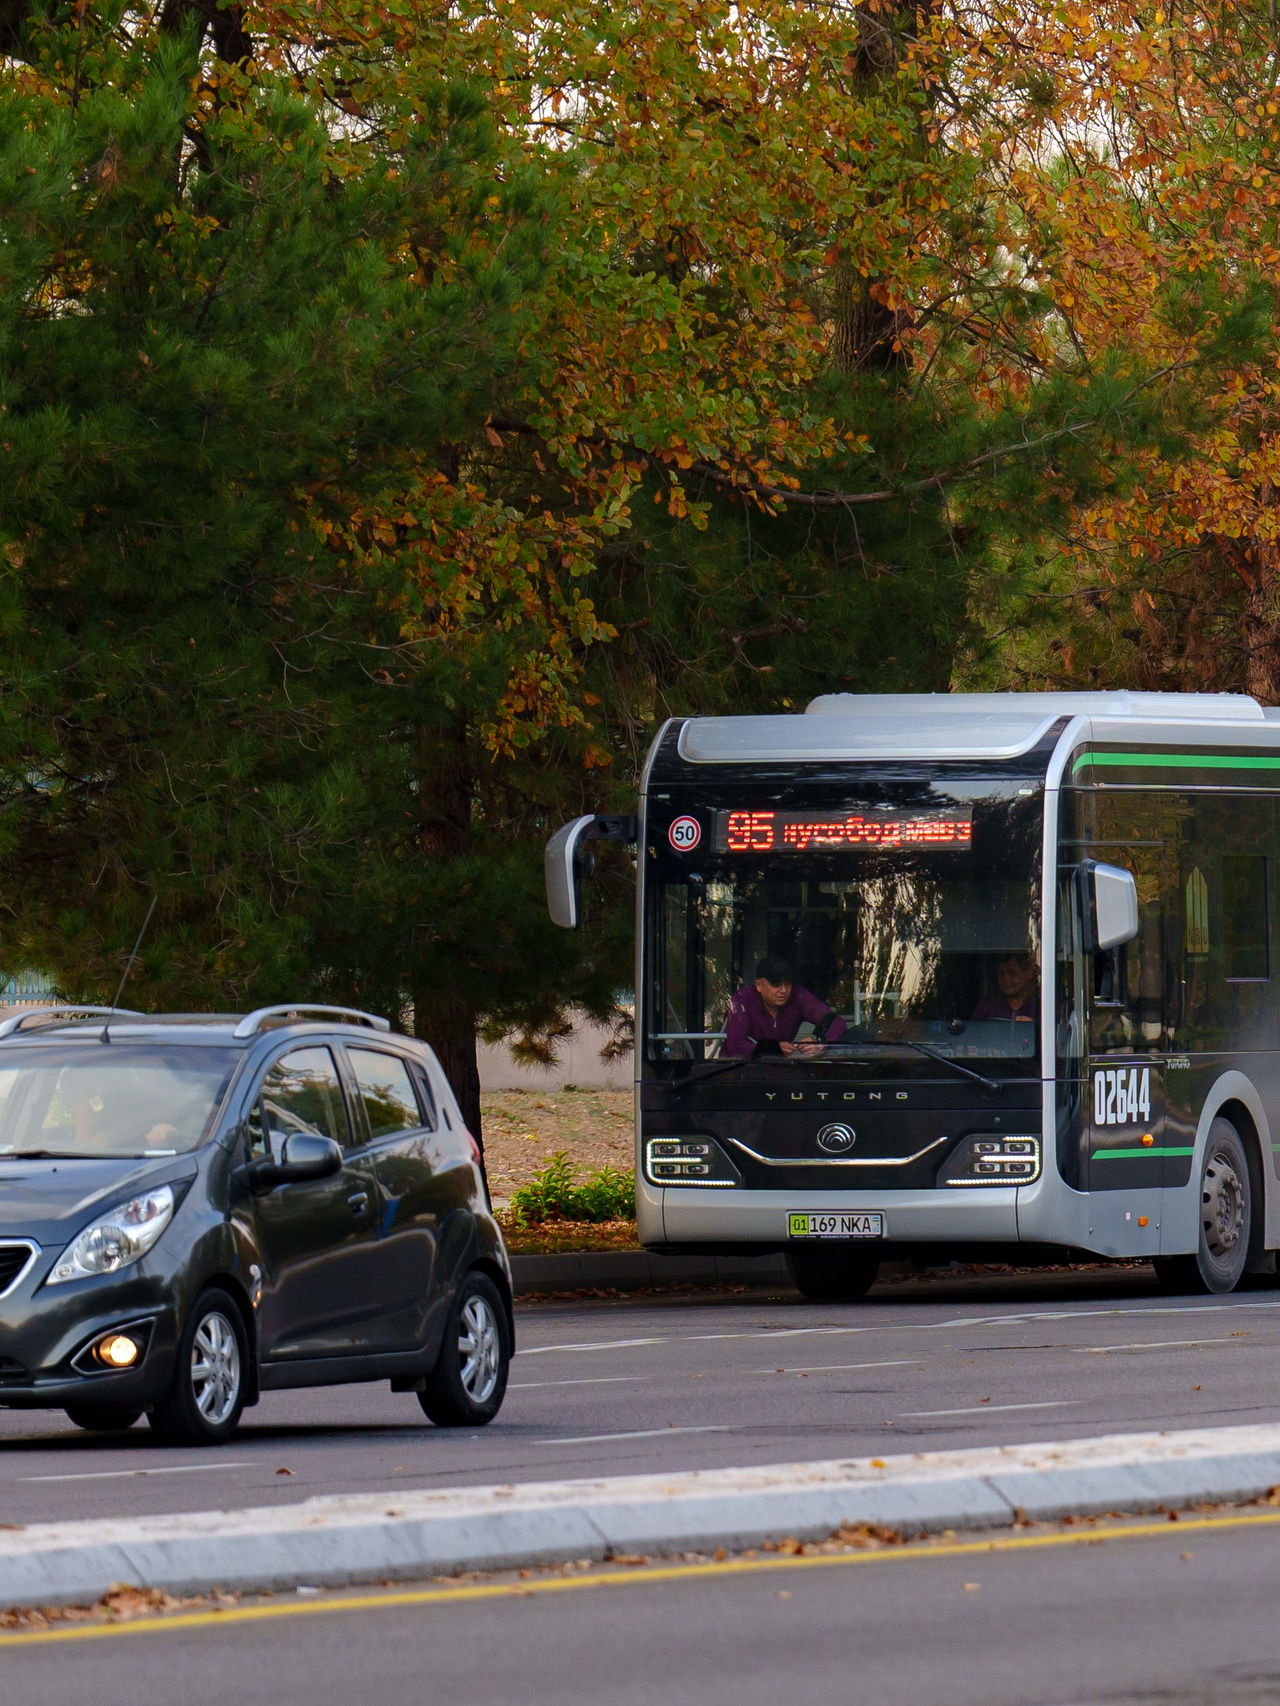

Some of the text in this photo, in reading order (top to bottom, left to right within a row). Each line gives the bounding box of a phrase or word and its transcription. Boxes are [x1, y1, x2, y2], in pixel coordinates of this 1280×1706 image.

[674, 825, 696, 842] 50
[727, 812, 775, 850] 95
[765, 1092, 908, 1100] YUTONG
[1094, 1067, 1151, 1125] 02644
[793, 1217, 872, 1232] 01 169 NKA
